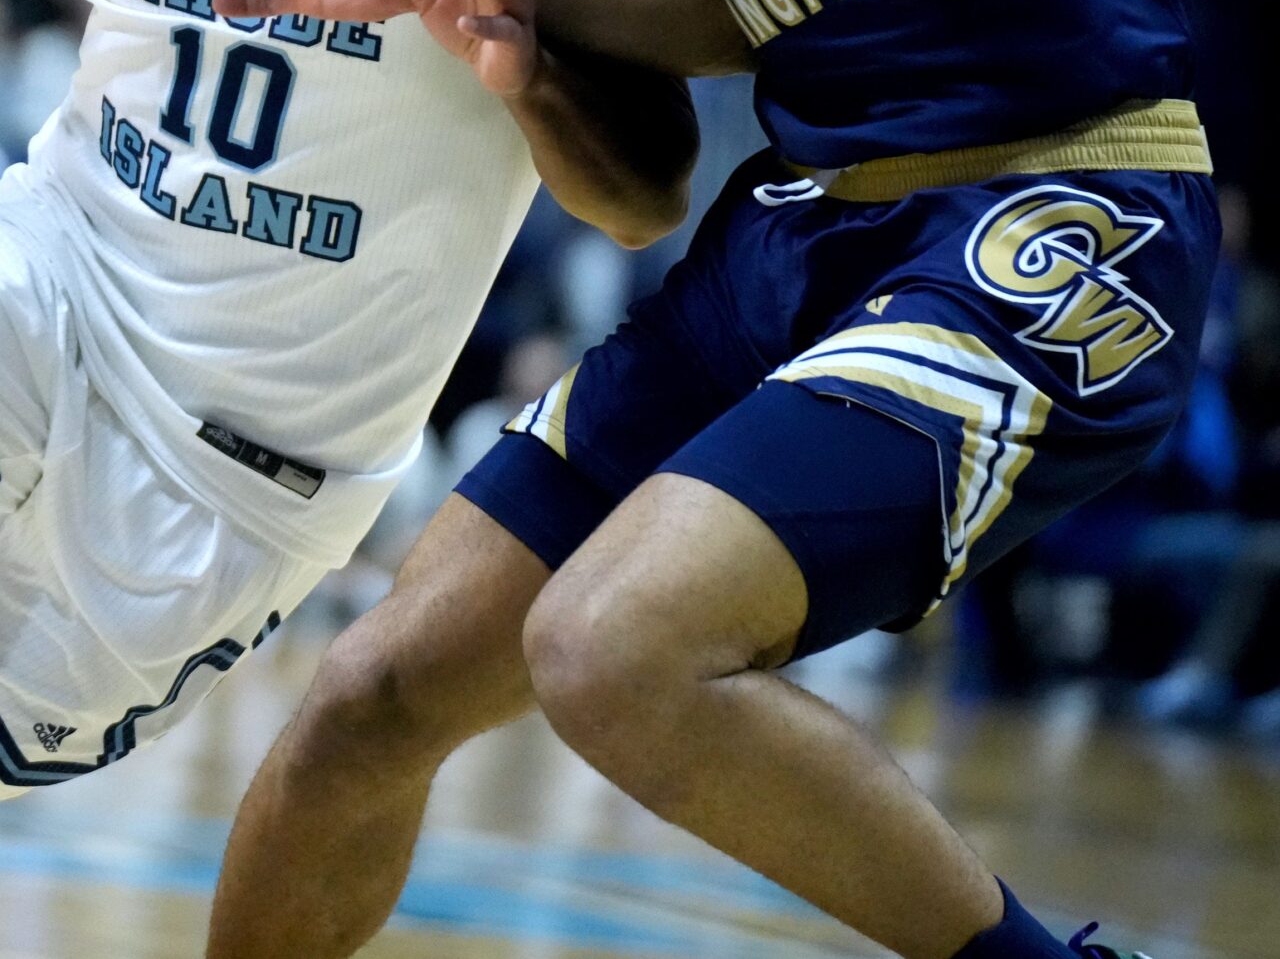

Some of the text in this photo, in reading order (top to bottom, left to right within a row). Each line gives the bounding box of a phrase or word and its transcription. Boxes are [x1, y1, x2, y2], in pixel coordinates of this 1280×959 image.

[99, 95, 362, 262] ISLAND
[159, 24, 297, 175] 10
[965, 184, 1174, 396] GW
[255, 450, 269, 466] M
